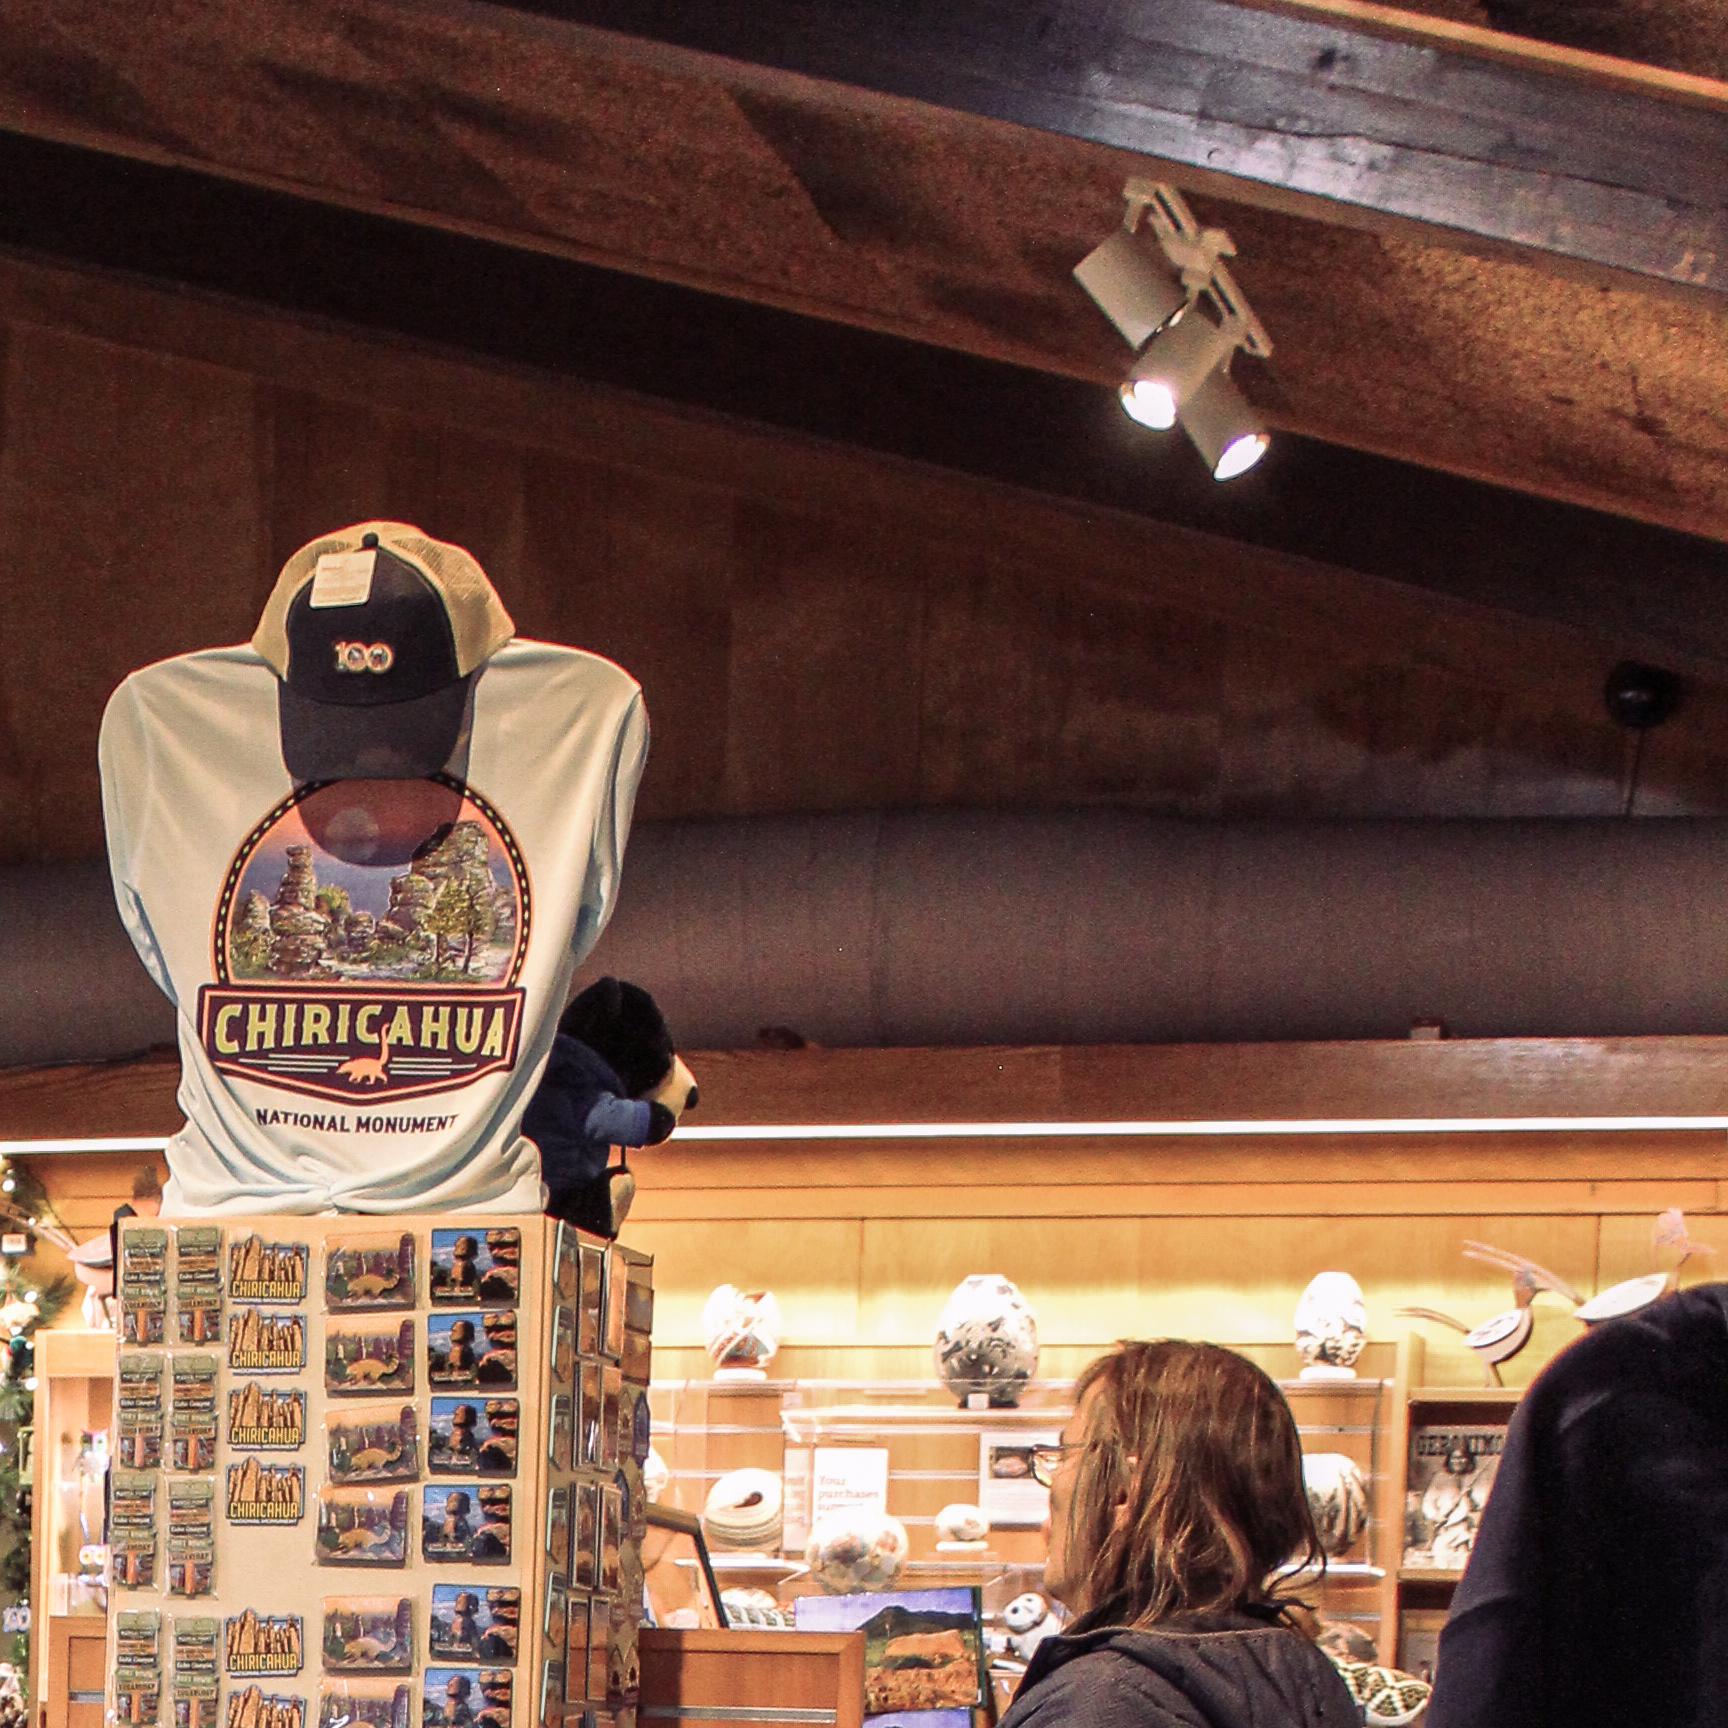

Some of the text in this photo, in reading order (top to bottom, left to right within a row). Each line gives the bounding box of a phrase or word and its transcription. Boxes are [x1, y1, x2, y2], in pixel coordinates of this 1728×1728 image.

[334, 641, 393, 674] 100
[214, 1003, 505, 1057] CHIRICAHUA
[255, 1108, 460, 1134] NATIONAL MONUMENT
[232, 1281, 300, 1297] CHIRICAHUA
[232, 1351, 300, 1367] CHIRICAHUA
[231, 1427, 299, 1443] CHIRICAHUA
[230, 1502, 298, 1518] CHIRICAHUA
[229, 1653, 298, 1671] CHIRICAHUA
